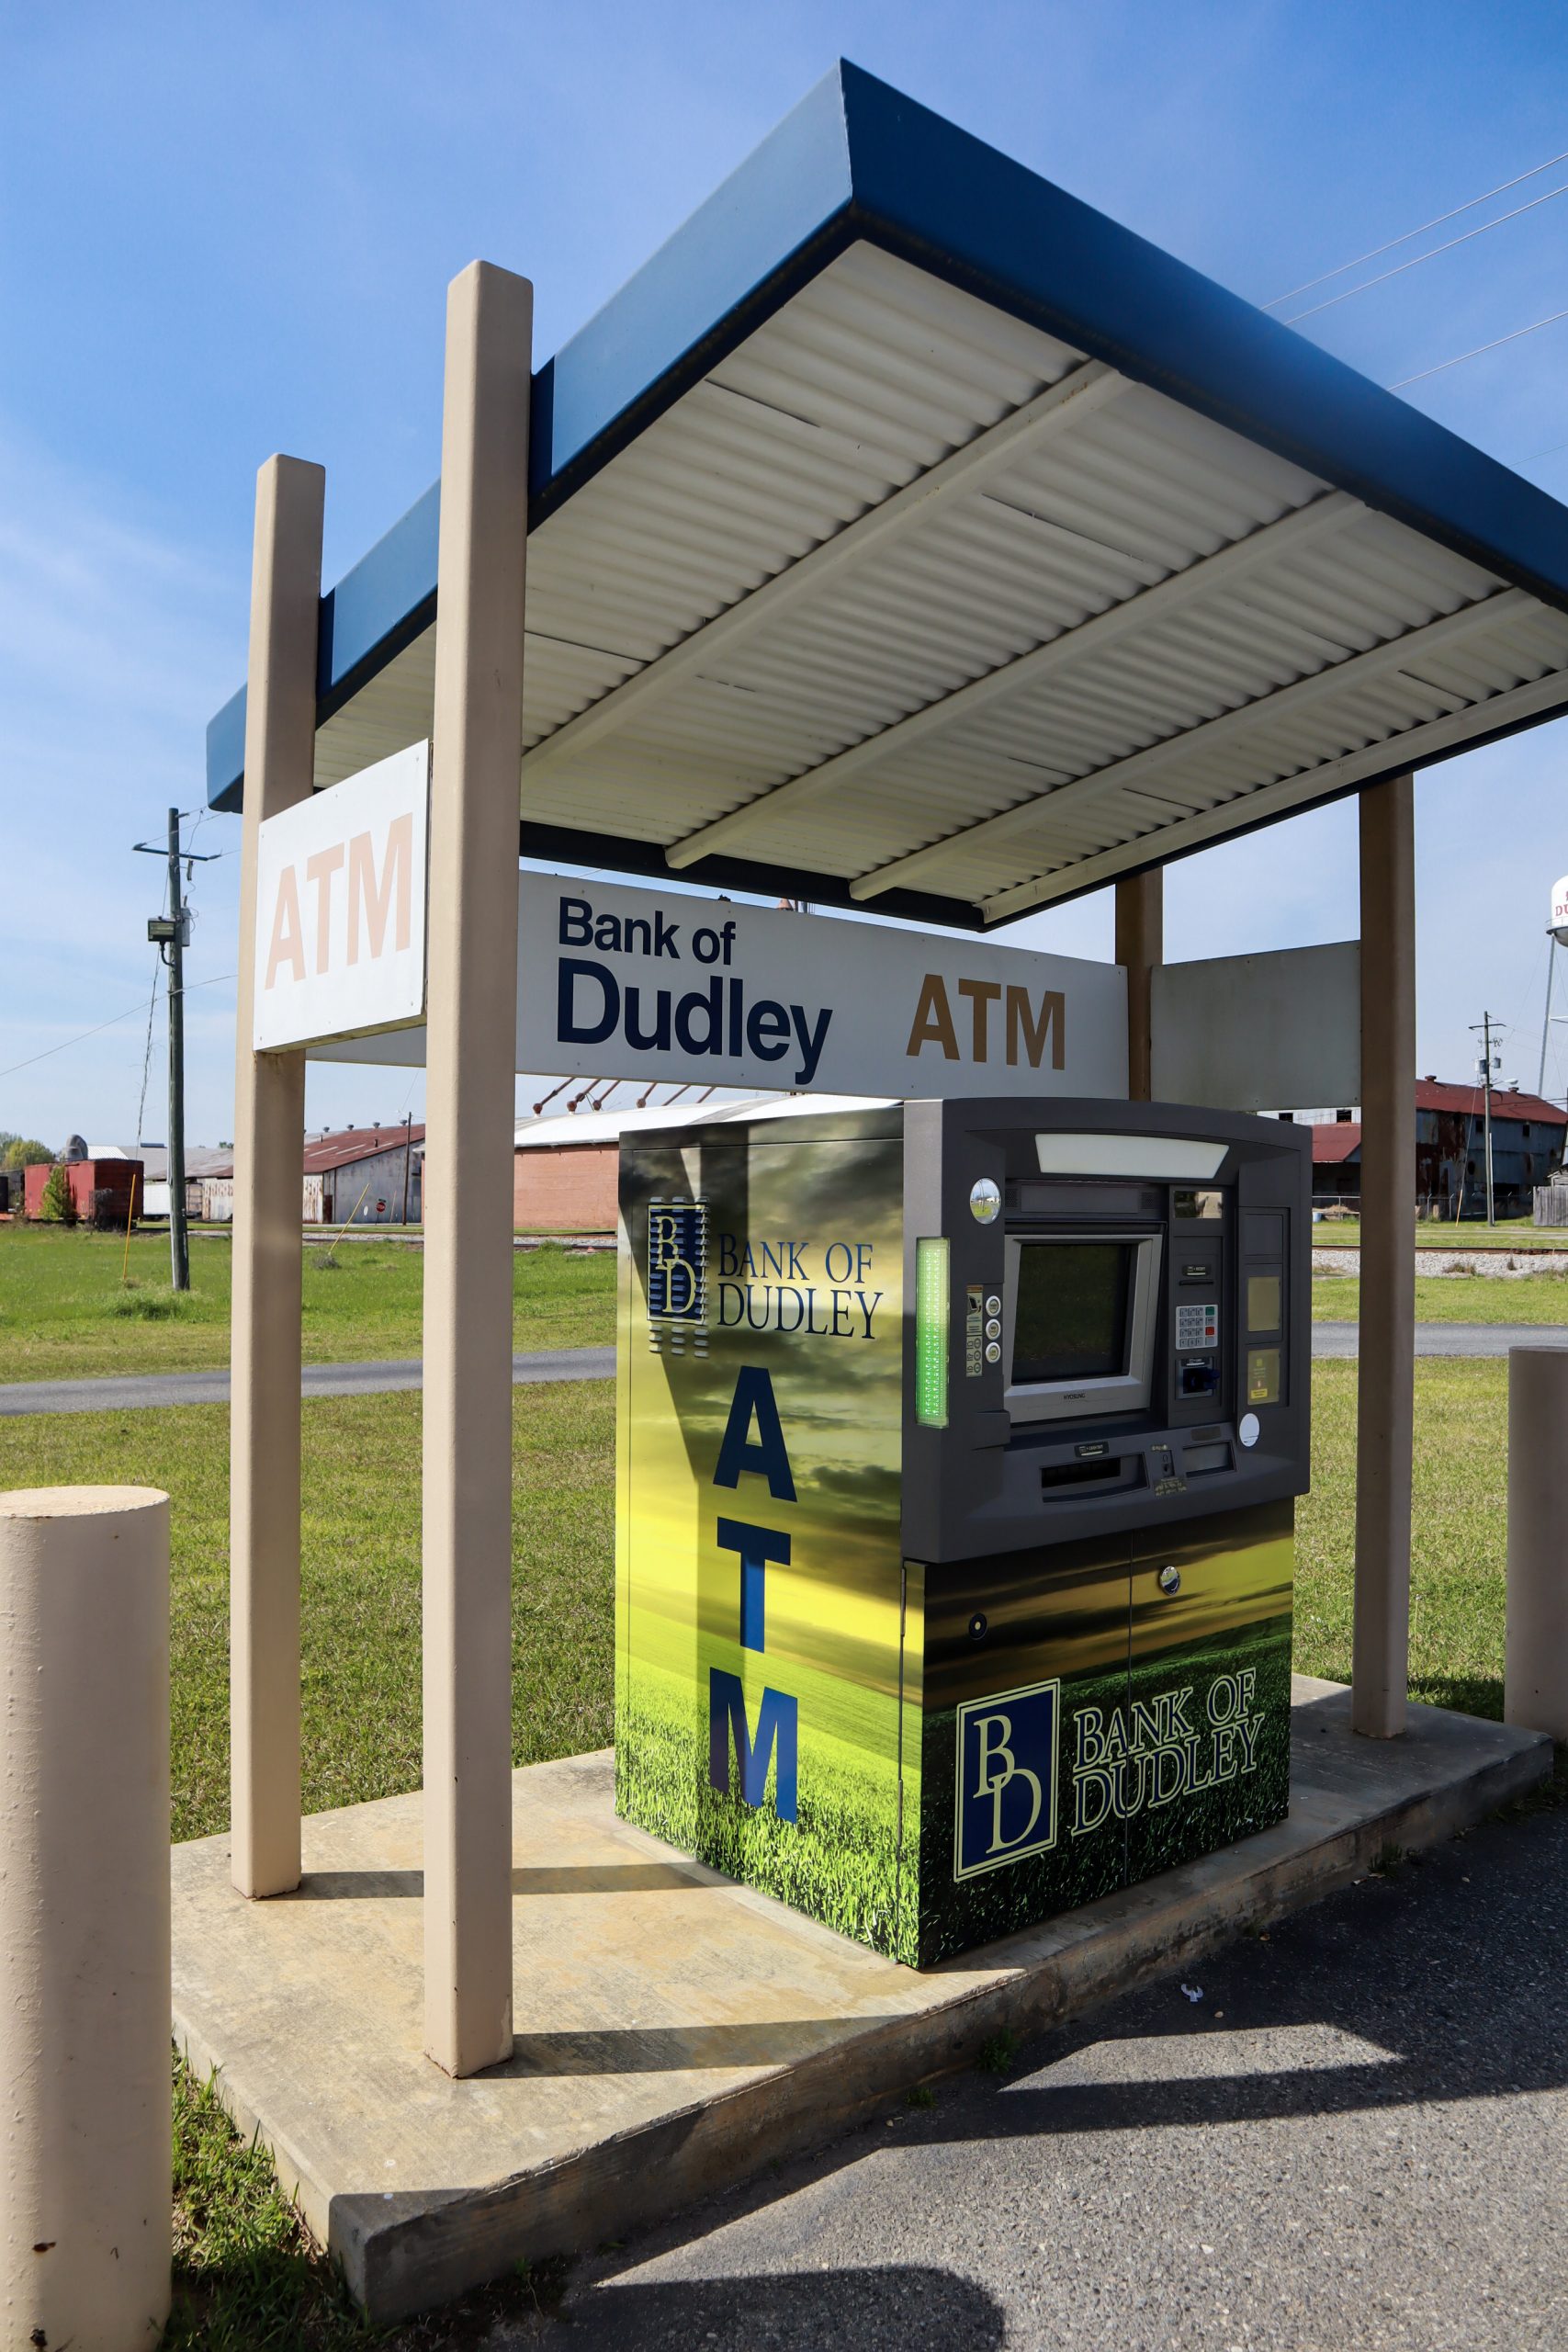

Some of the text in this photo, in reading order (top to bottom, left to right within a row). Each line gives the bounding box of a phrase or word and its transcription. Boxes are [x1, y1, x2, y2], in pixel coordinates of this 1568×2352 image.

[265, 812, 412, 990] ATM
[558, 896, 736, 966] Bank of
[557, 957, 833, 1085] Dudley
[906, 973, 1066, 1071] ATM
[718, 1234, 873, 1283] BANK OF
[717, 1283, 884, 1340] DUDLEY
[710, 1365, 797, 1825] ATM
[1073, 1667, 1257, 1772] BANK OF
[1071, 1713, 1265, 1837] DUDLEY
